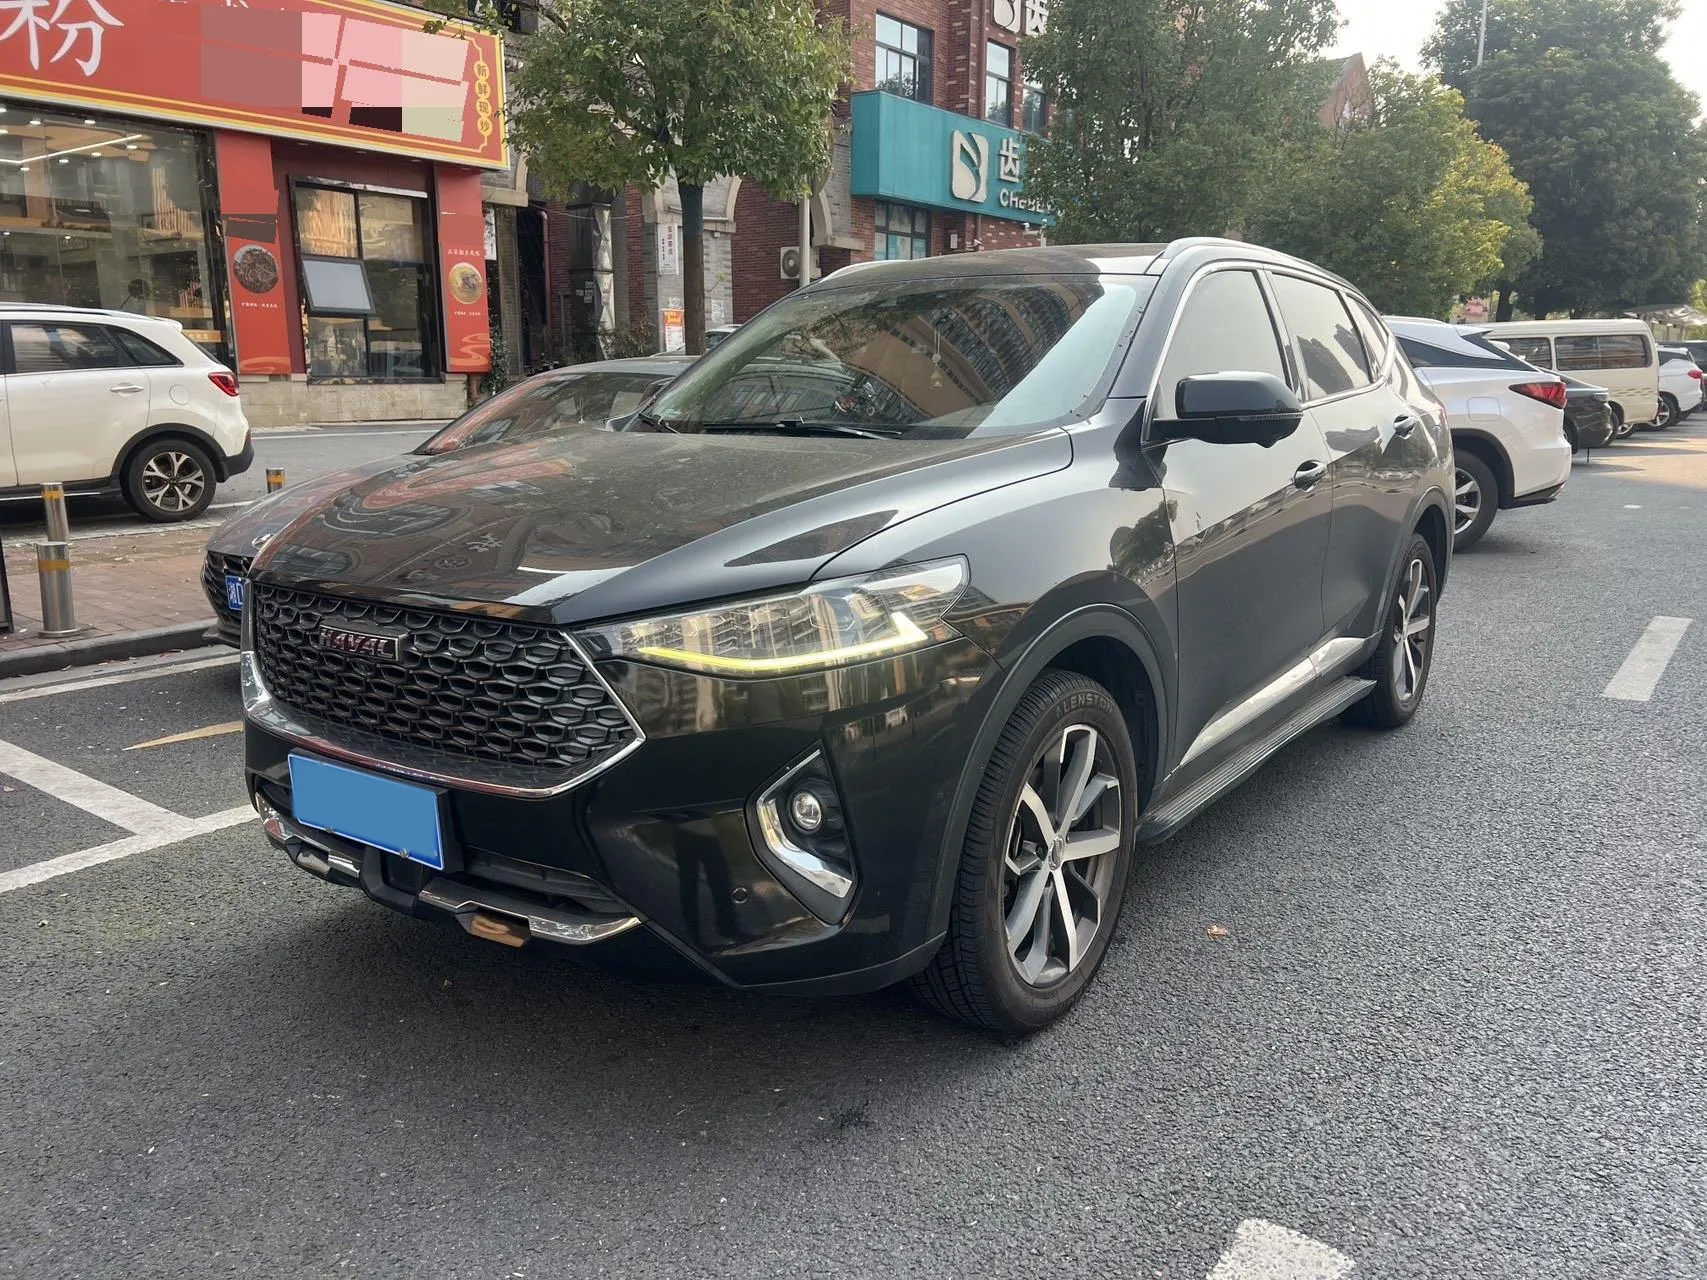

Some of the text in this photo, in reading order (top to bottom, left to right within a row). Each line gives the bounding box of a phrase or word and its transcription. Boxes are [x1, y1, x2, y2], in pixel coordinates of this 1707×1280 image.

[0, 0, 125, 77] 粉
[476, 64, 490, 132] 新鲜现炒
[1000, 137, 1020, 182] 齿
[320, 629, 394, 659] HAVAL
